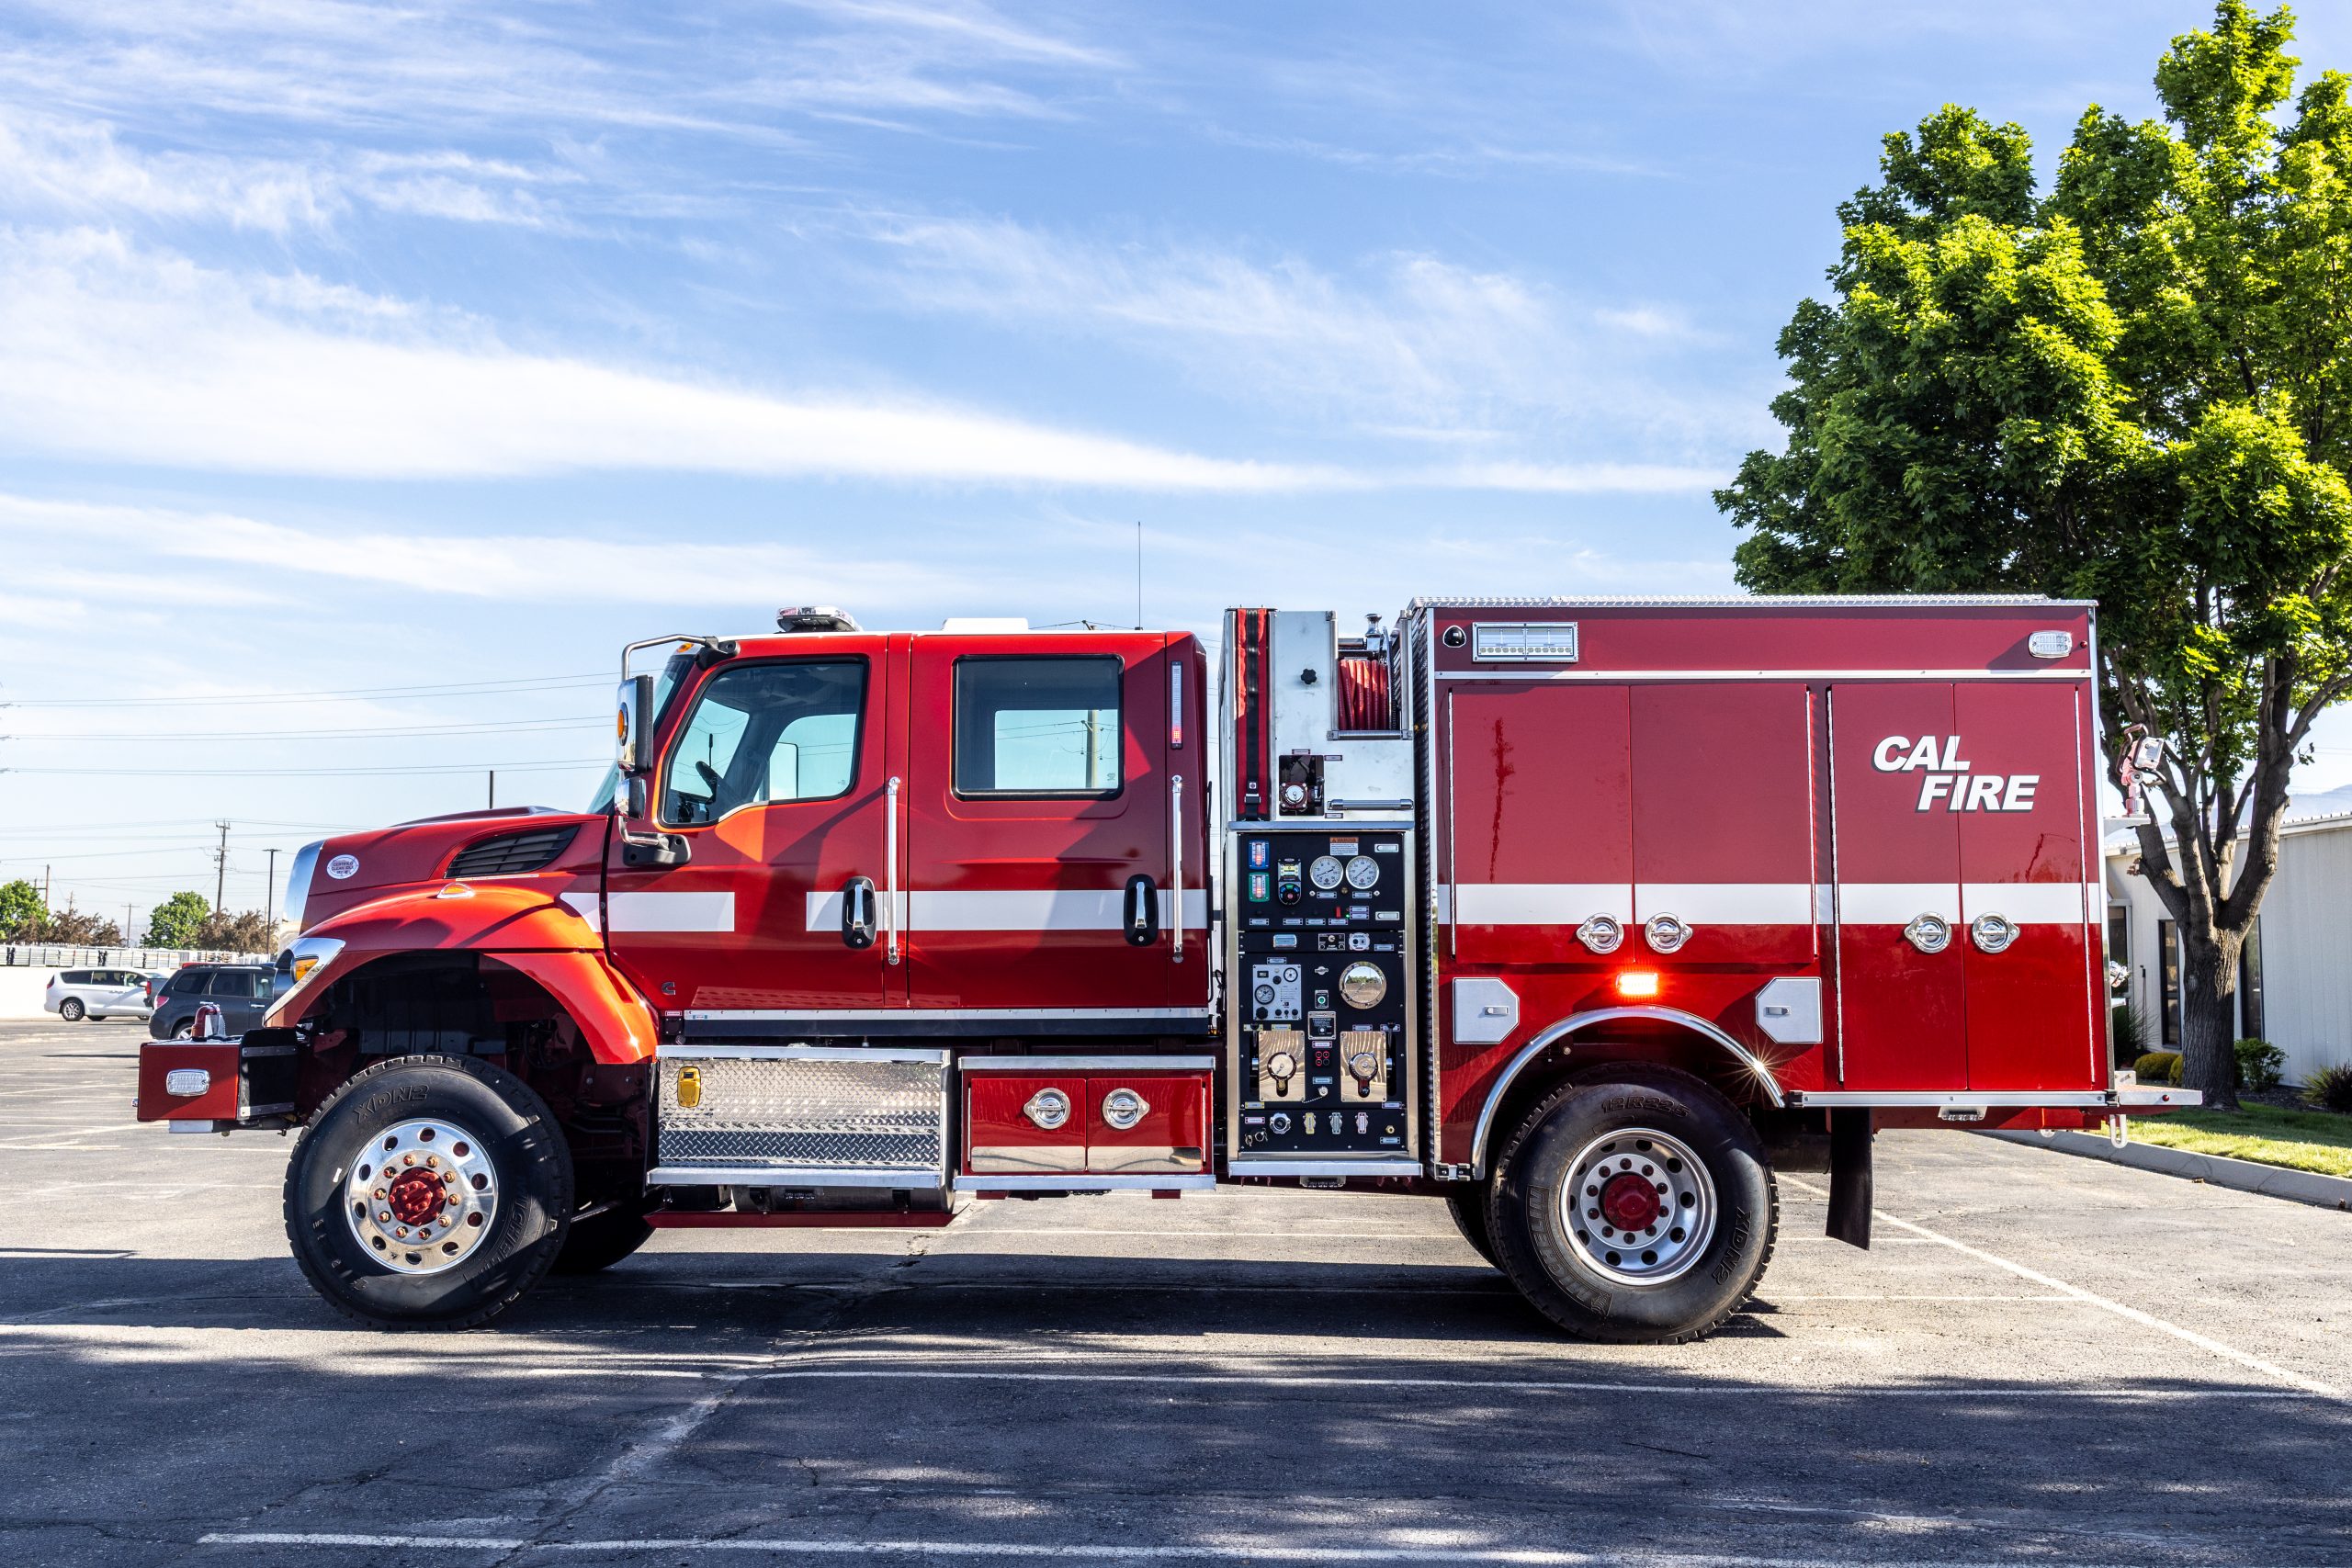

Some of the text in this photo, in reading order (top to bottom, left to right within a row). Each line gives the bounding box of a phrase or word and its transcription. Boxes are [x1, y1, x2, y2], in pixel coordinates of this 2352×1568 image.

[1871, 735, 1971, 773] CAL
[1915, 774, 2040, 813] FIRE
[353, 1085, 430, 1123] XDN2
[1529, 1188, 1595, 1303] MICHELIN
[1713, 1206, 1751, 1285] XDN2
